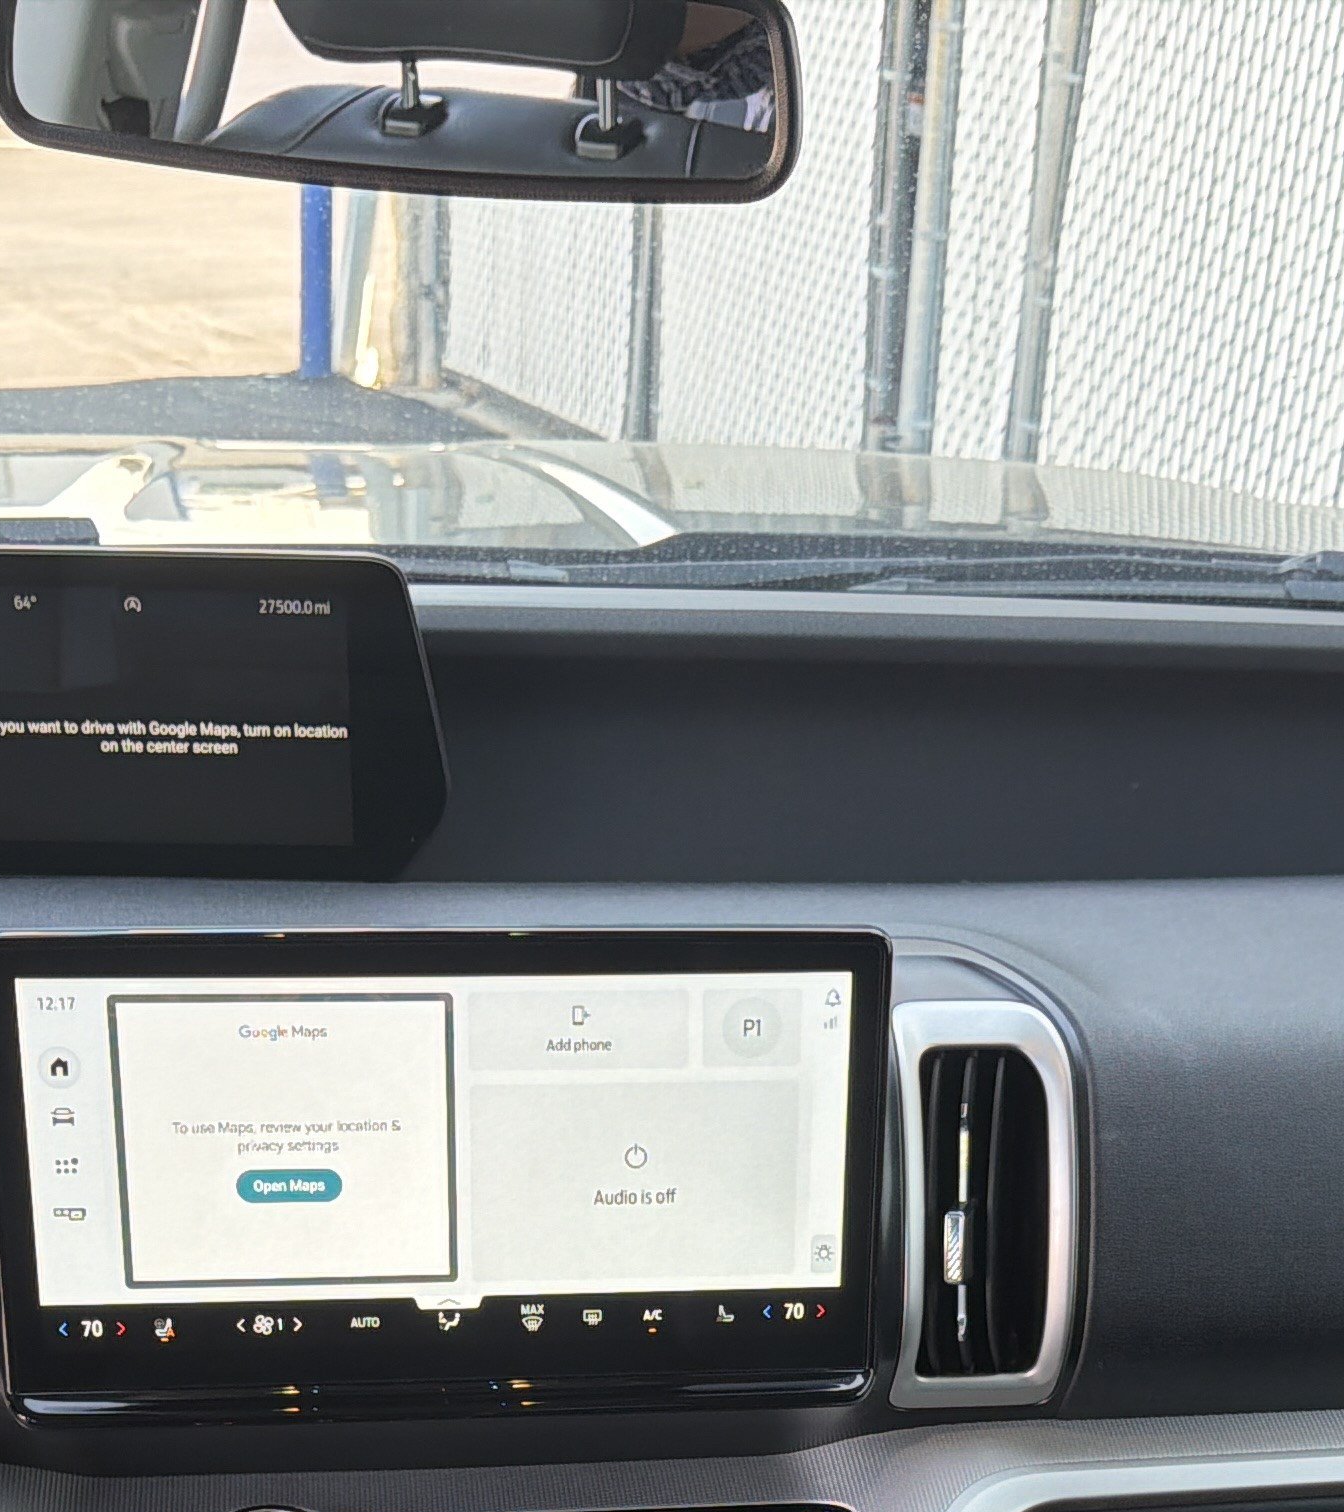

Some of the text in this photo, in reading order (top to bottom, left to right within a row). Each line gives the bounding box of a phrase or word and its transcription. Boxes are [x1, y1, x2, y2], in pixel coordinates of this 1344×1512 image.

[0, 721, 25, 737] you
[27, 720, 62, 734] want
[63, 720, 78, 734] to
[81, 719, 115, 735] drive
[117, 720, 146, 735] with
[149, 720, 197, 739] Google
[199, 721, 241, 740] Maps,
[243, 723, 271, 737] turn
[273, 725, 291, 737] on
[293, 722, 348, 739] location
[100, 738, 239, 754] on the center screen
[238, 1024, 327, 1041] Google Maps
[743, 1019, 761, 1037] P1
[546, 1039, 613, 1053] Add phone
[172, 1119, 402, 1136] To use Maps, review your location &
[237, 1138, 340, 1156] privacy settings
[253, 1179, 326, 1196] Open Maps
[593, 1187, 677, 1206] Audio is off
[520, 1303, 545, 1316] MAX
[642, 1308, 663, 1322] A/C
[782, 1302, 805, 1320] 70
[80, 1319, 104, 1338] 70
[277, 1318, 284, 1331] 1
[350, 1316, 381, 1329] AUTO
